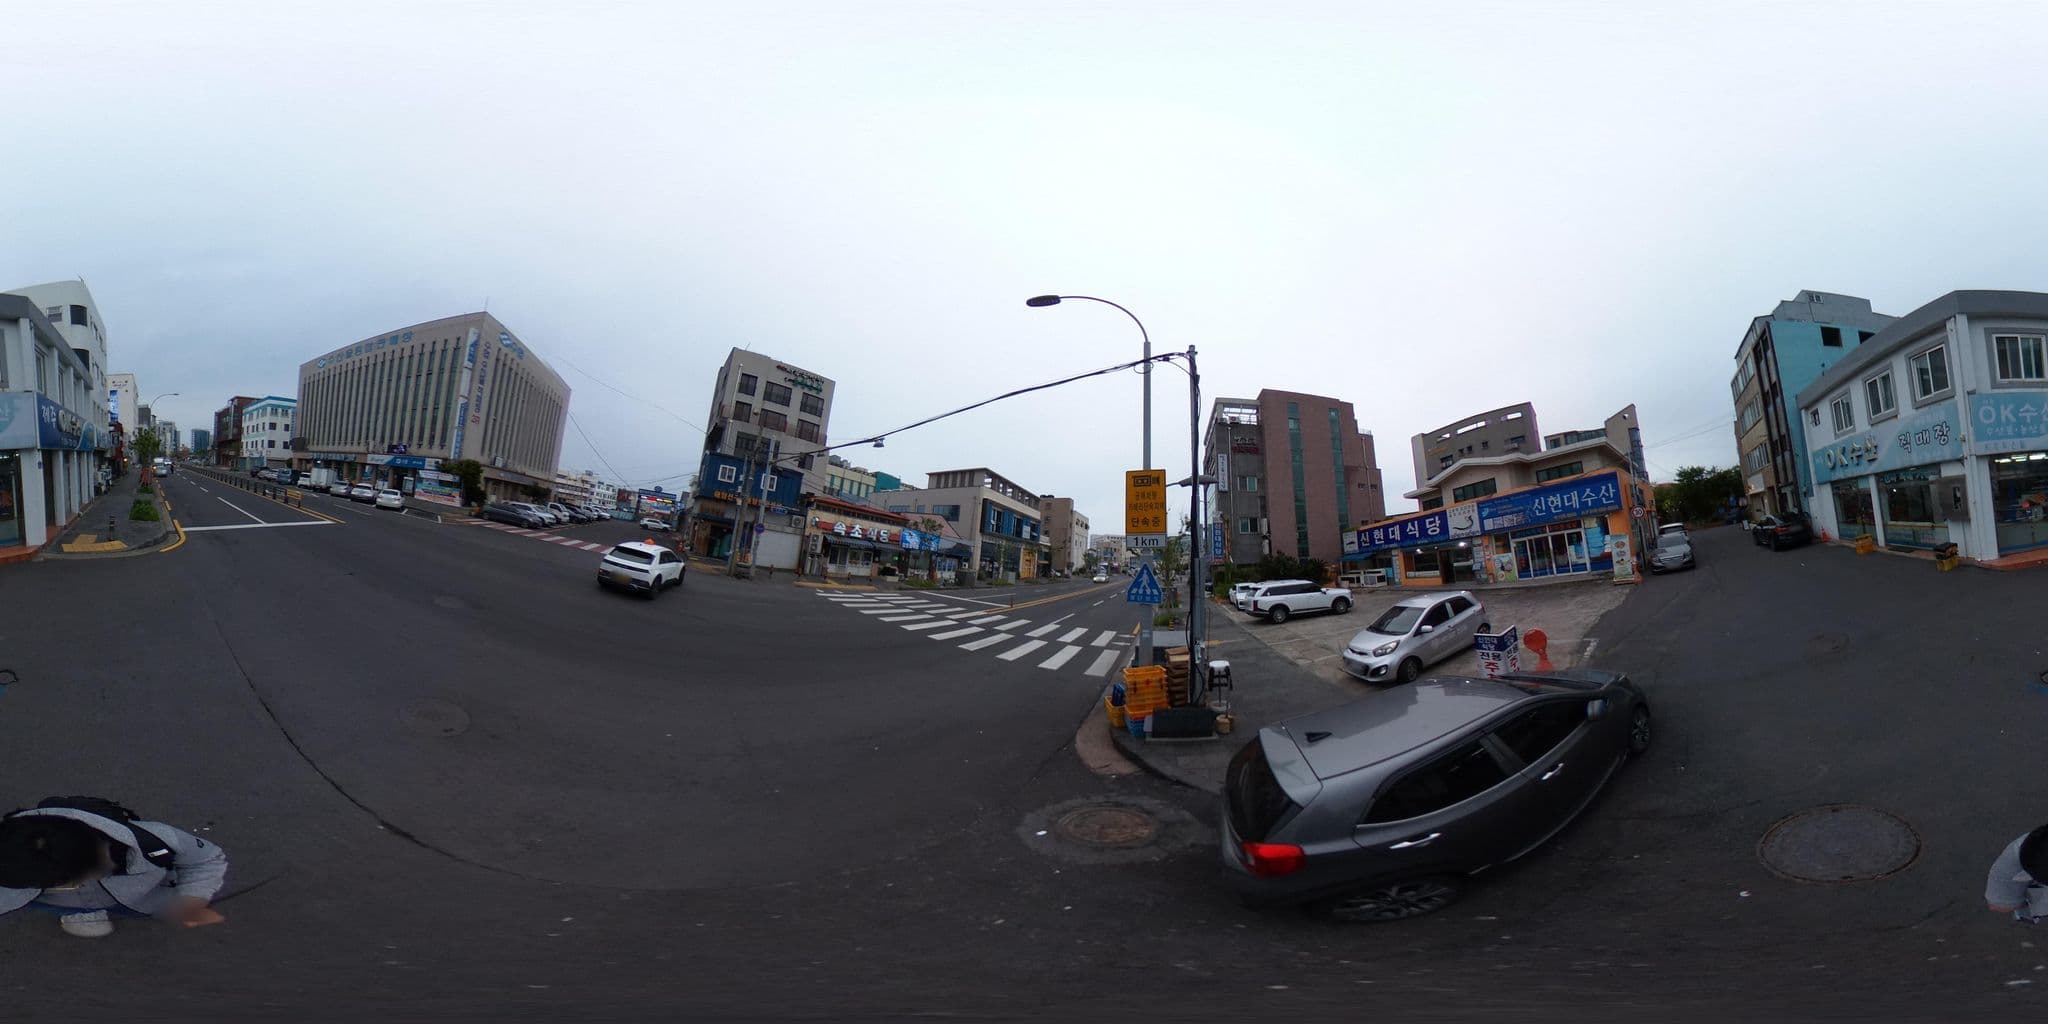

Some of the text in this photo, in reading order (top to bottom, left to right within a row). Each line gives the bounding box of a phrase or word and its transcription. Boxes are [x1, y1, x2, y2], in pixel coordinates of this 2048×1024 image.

[1824, 421, 1950, 470] OK수산 직매장
[1532, 483, 1617, 516] 신현대수산
[833, 521, 889, 543] 속초식당
[1131, 517, 1161, 528] 단속중
[1360, 515, 1441, 547] 신현대식당
[1133, 537, 1159, 547] 1km
